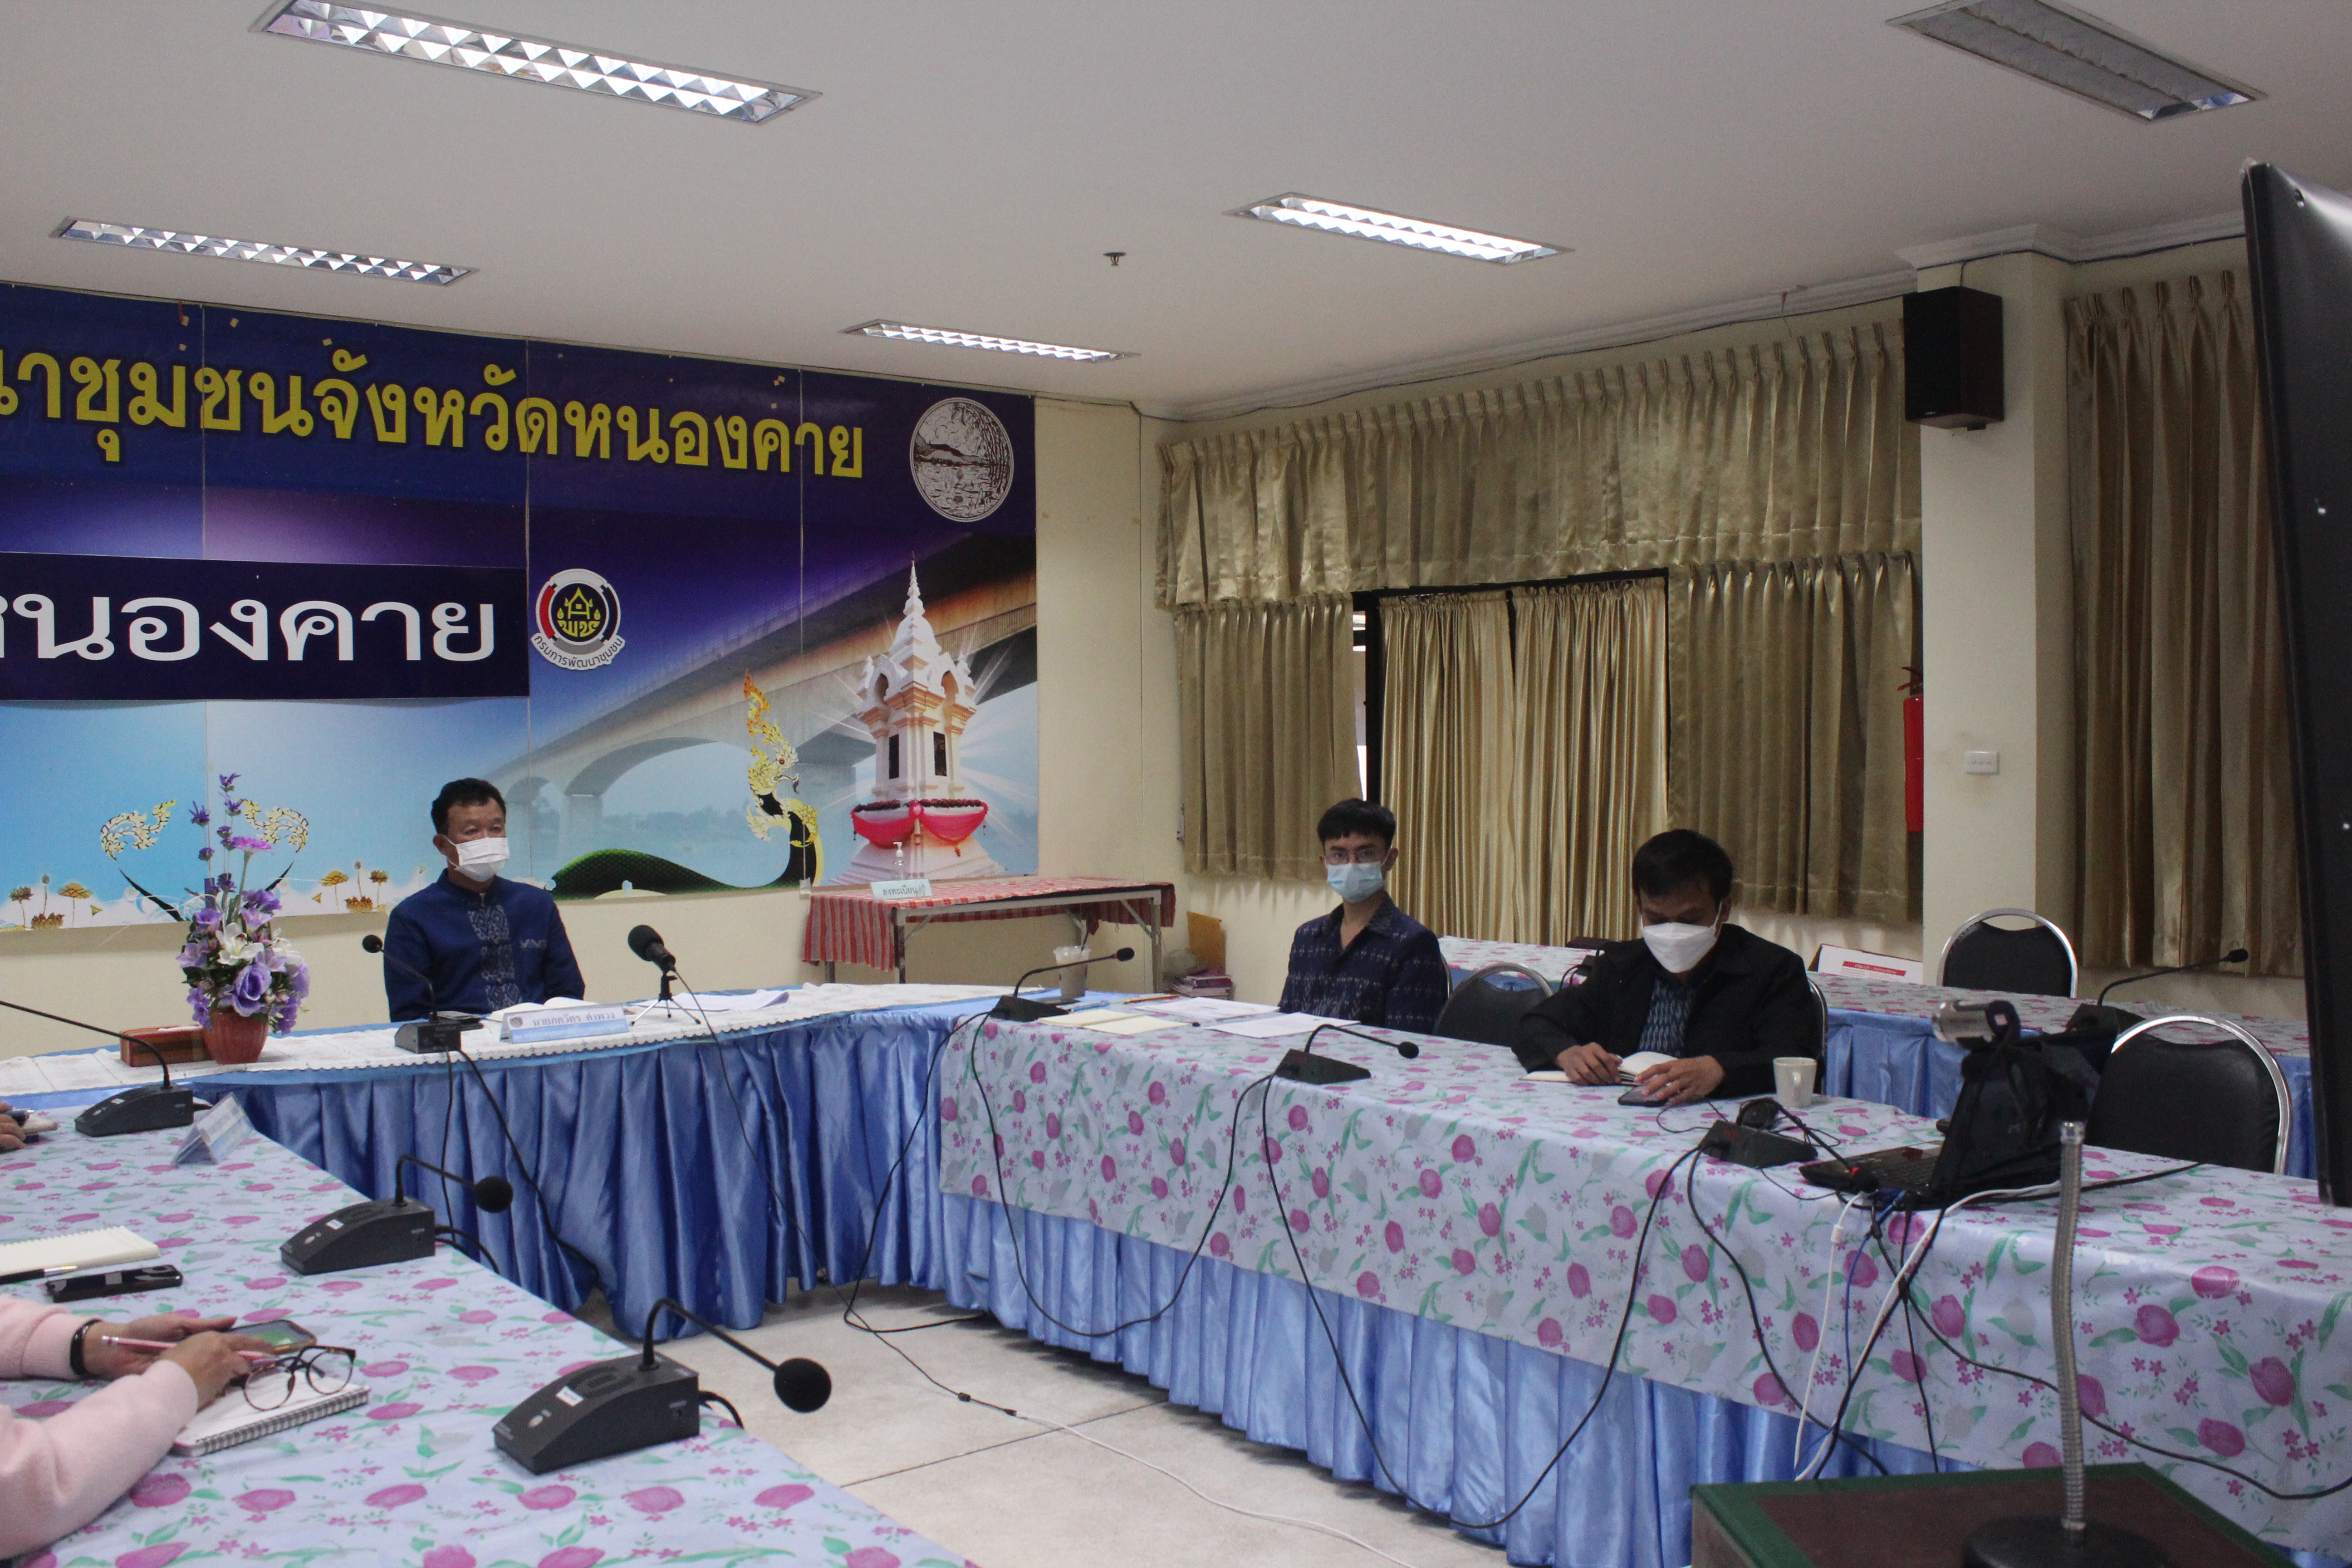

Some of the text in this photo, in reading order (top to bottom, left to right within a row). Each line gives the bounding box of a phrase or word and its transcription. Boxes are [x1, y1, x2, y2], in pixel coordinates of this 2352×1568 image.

[0, 593, 495, 662] นองคาย
[534, 635, 623, 668] กรมการพัฒนาชุมชน
[882, 885, 917, 896] ลงทะเบียน
